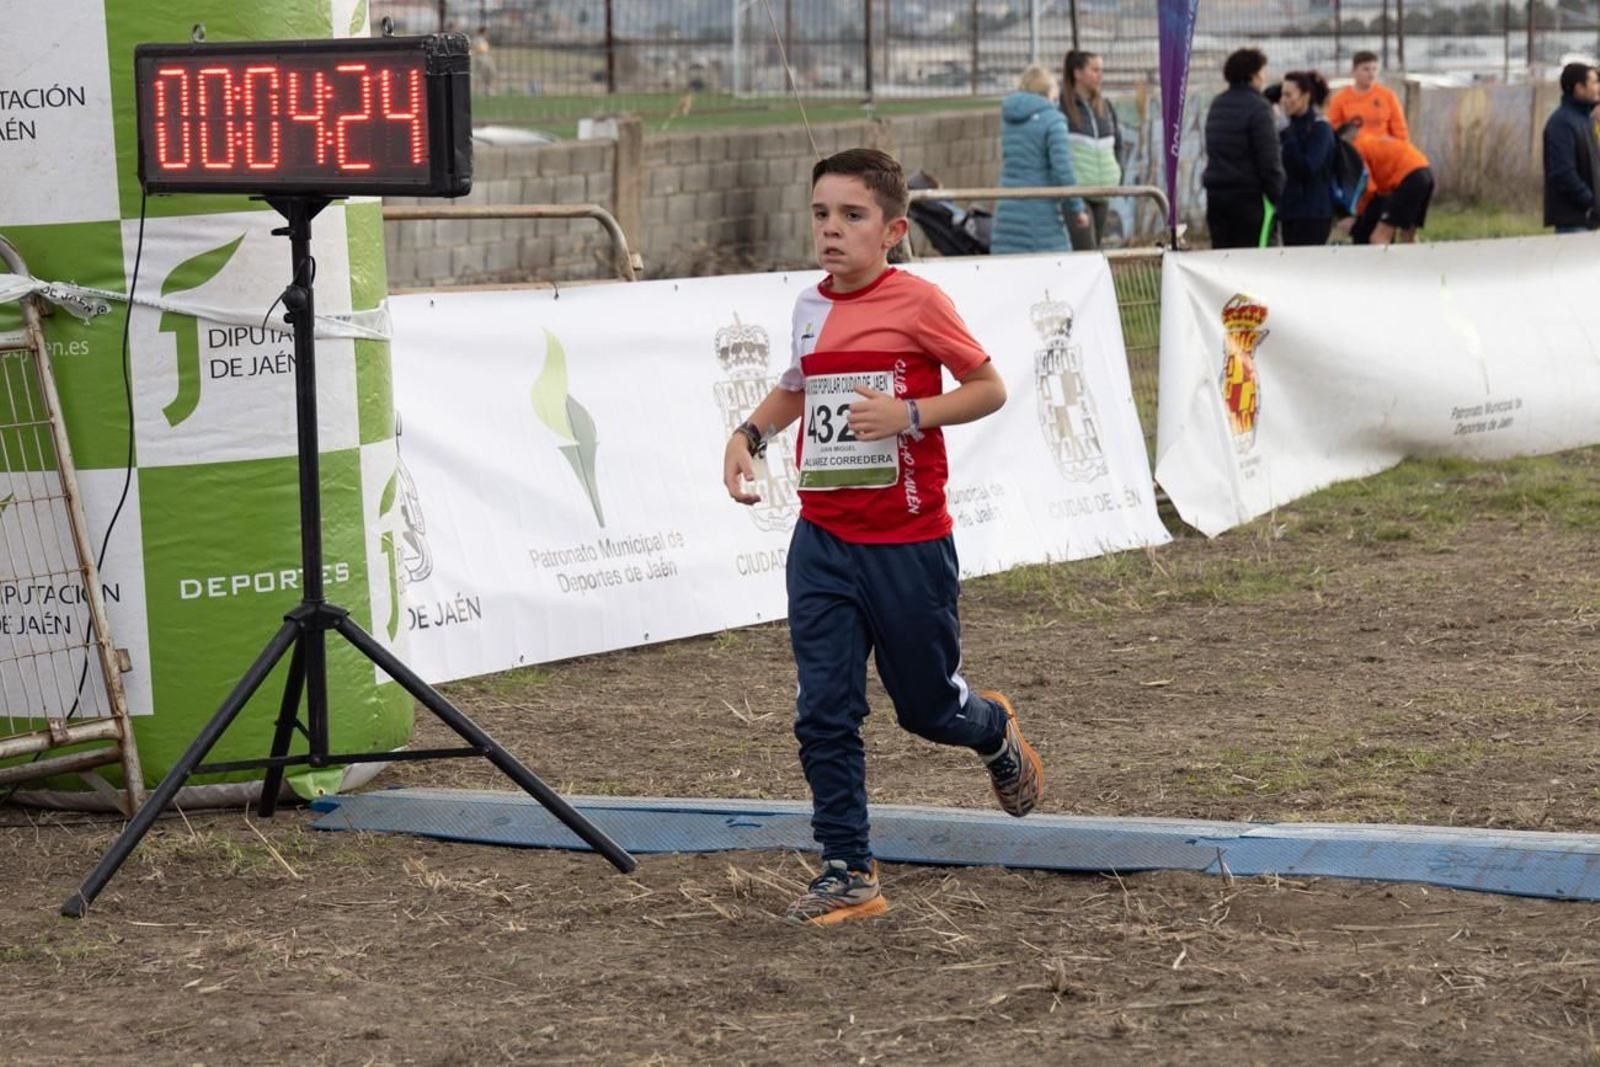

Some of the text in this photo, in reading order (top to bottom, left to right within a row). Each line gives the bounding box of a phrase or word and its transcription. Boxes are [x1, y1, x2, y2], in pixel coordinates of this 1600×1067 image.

[154, 64, 425, 169] 00:04:24
[208, 326, 296, 348] DIPUTA
[210, 357, 244, 379] DE
[894, 358, 908, 395] CLUB
[829, 454, 894, 466] CORREDERA
[528, 543, 598, 569] Patronato
[598, 531, 664, 560] Municipal
[180, 562, 349, 599] DEPORES
[556, 569, 623, 595] Deportes
[624, 563, 644, 584] de
[17, 611, 71, 635] JAÉN
[434, 591, 482, 627] JAÉN
